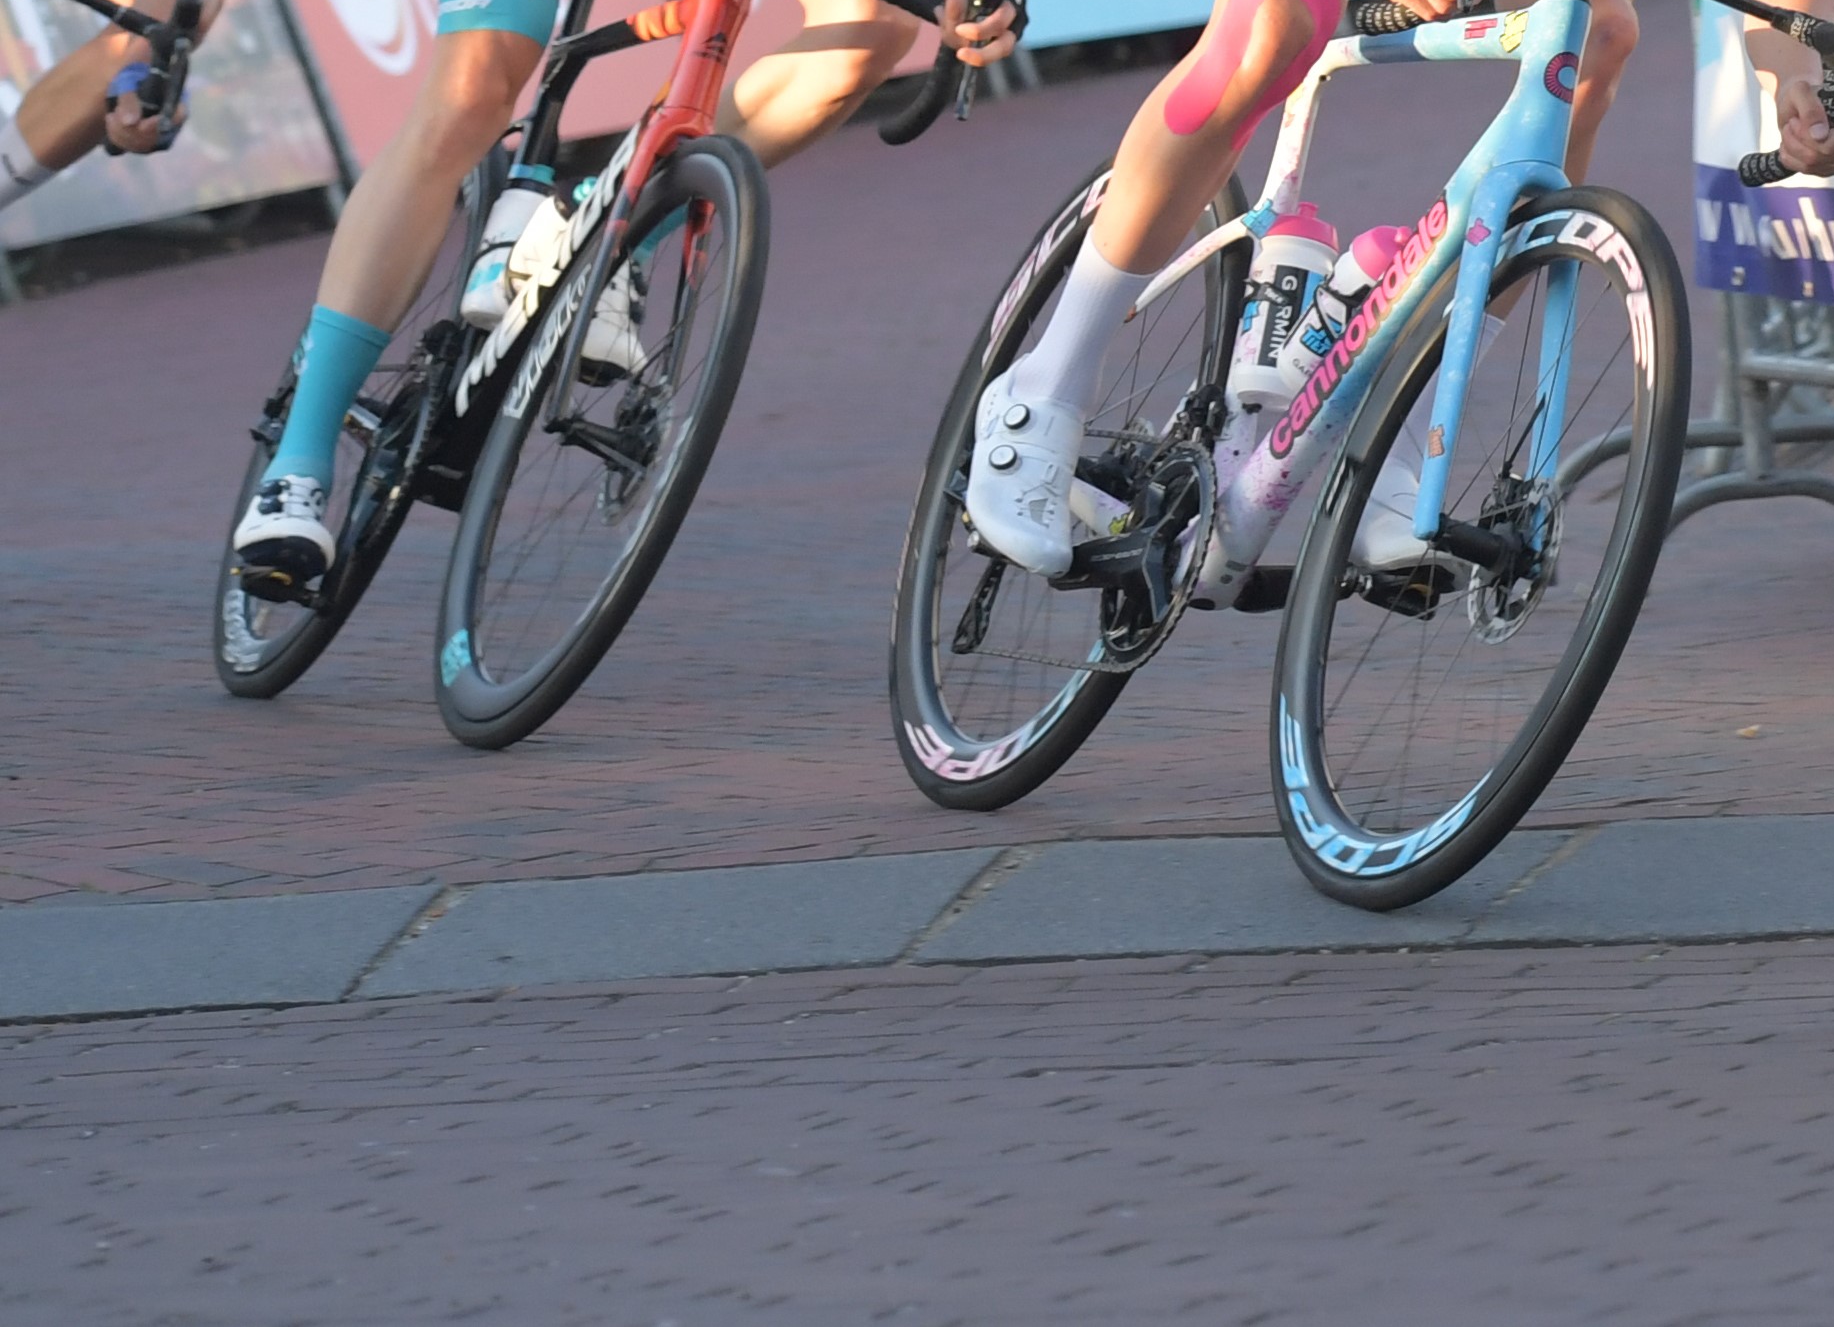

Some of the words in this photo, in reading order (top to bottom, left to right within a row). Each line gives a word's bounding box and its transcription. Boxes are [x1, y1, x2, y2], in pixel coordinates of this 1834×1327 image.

[1267, 275, 1298, 360] GRMIN
[1268, 196, 1449, 459] cannondale
[1279, 692, 1494, 875] SCOPE
